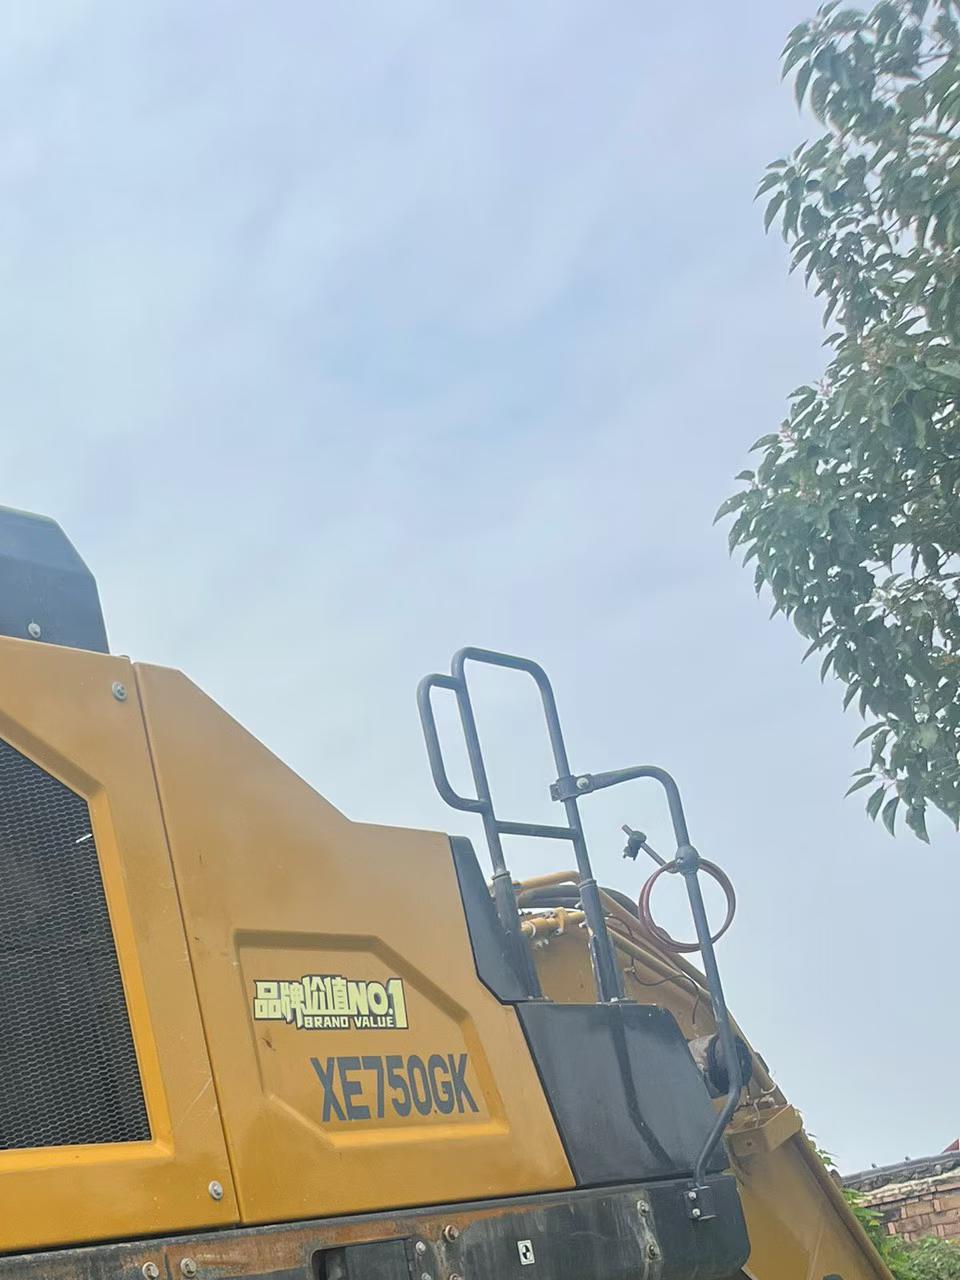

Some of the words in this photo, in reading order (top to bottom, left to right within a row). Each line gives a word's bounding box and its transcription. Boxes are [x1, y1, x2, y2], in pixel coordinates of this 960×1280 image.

[304, 1016, 349, 1028] BRAND
[353, 1016, 395, 1028] VALUE
[310, 1053, 479, 1122] XE750GK
